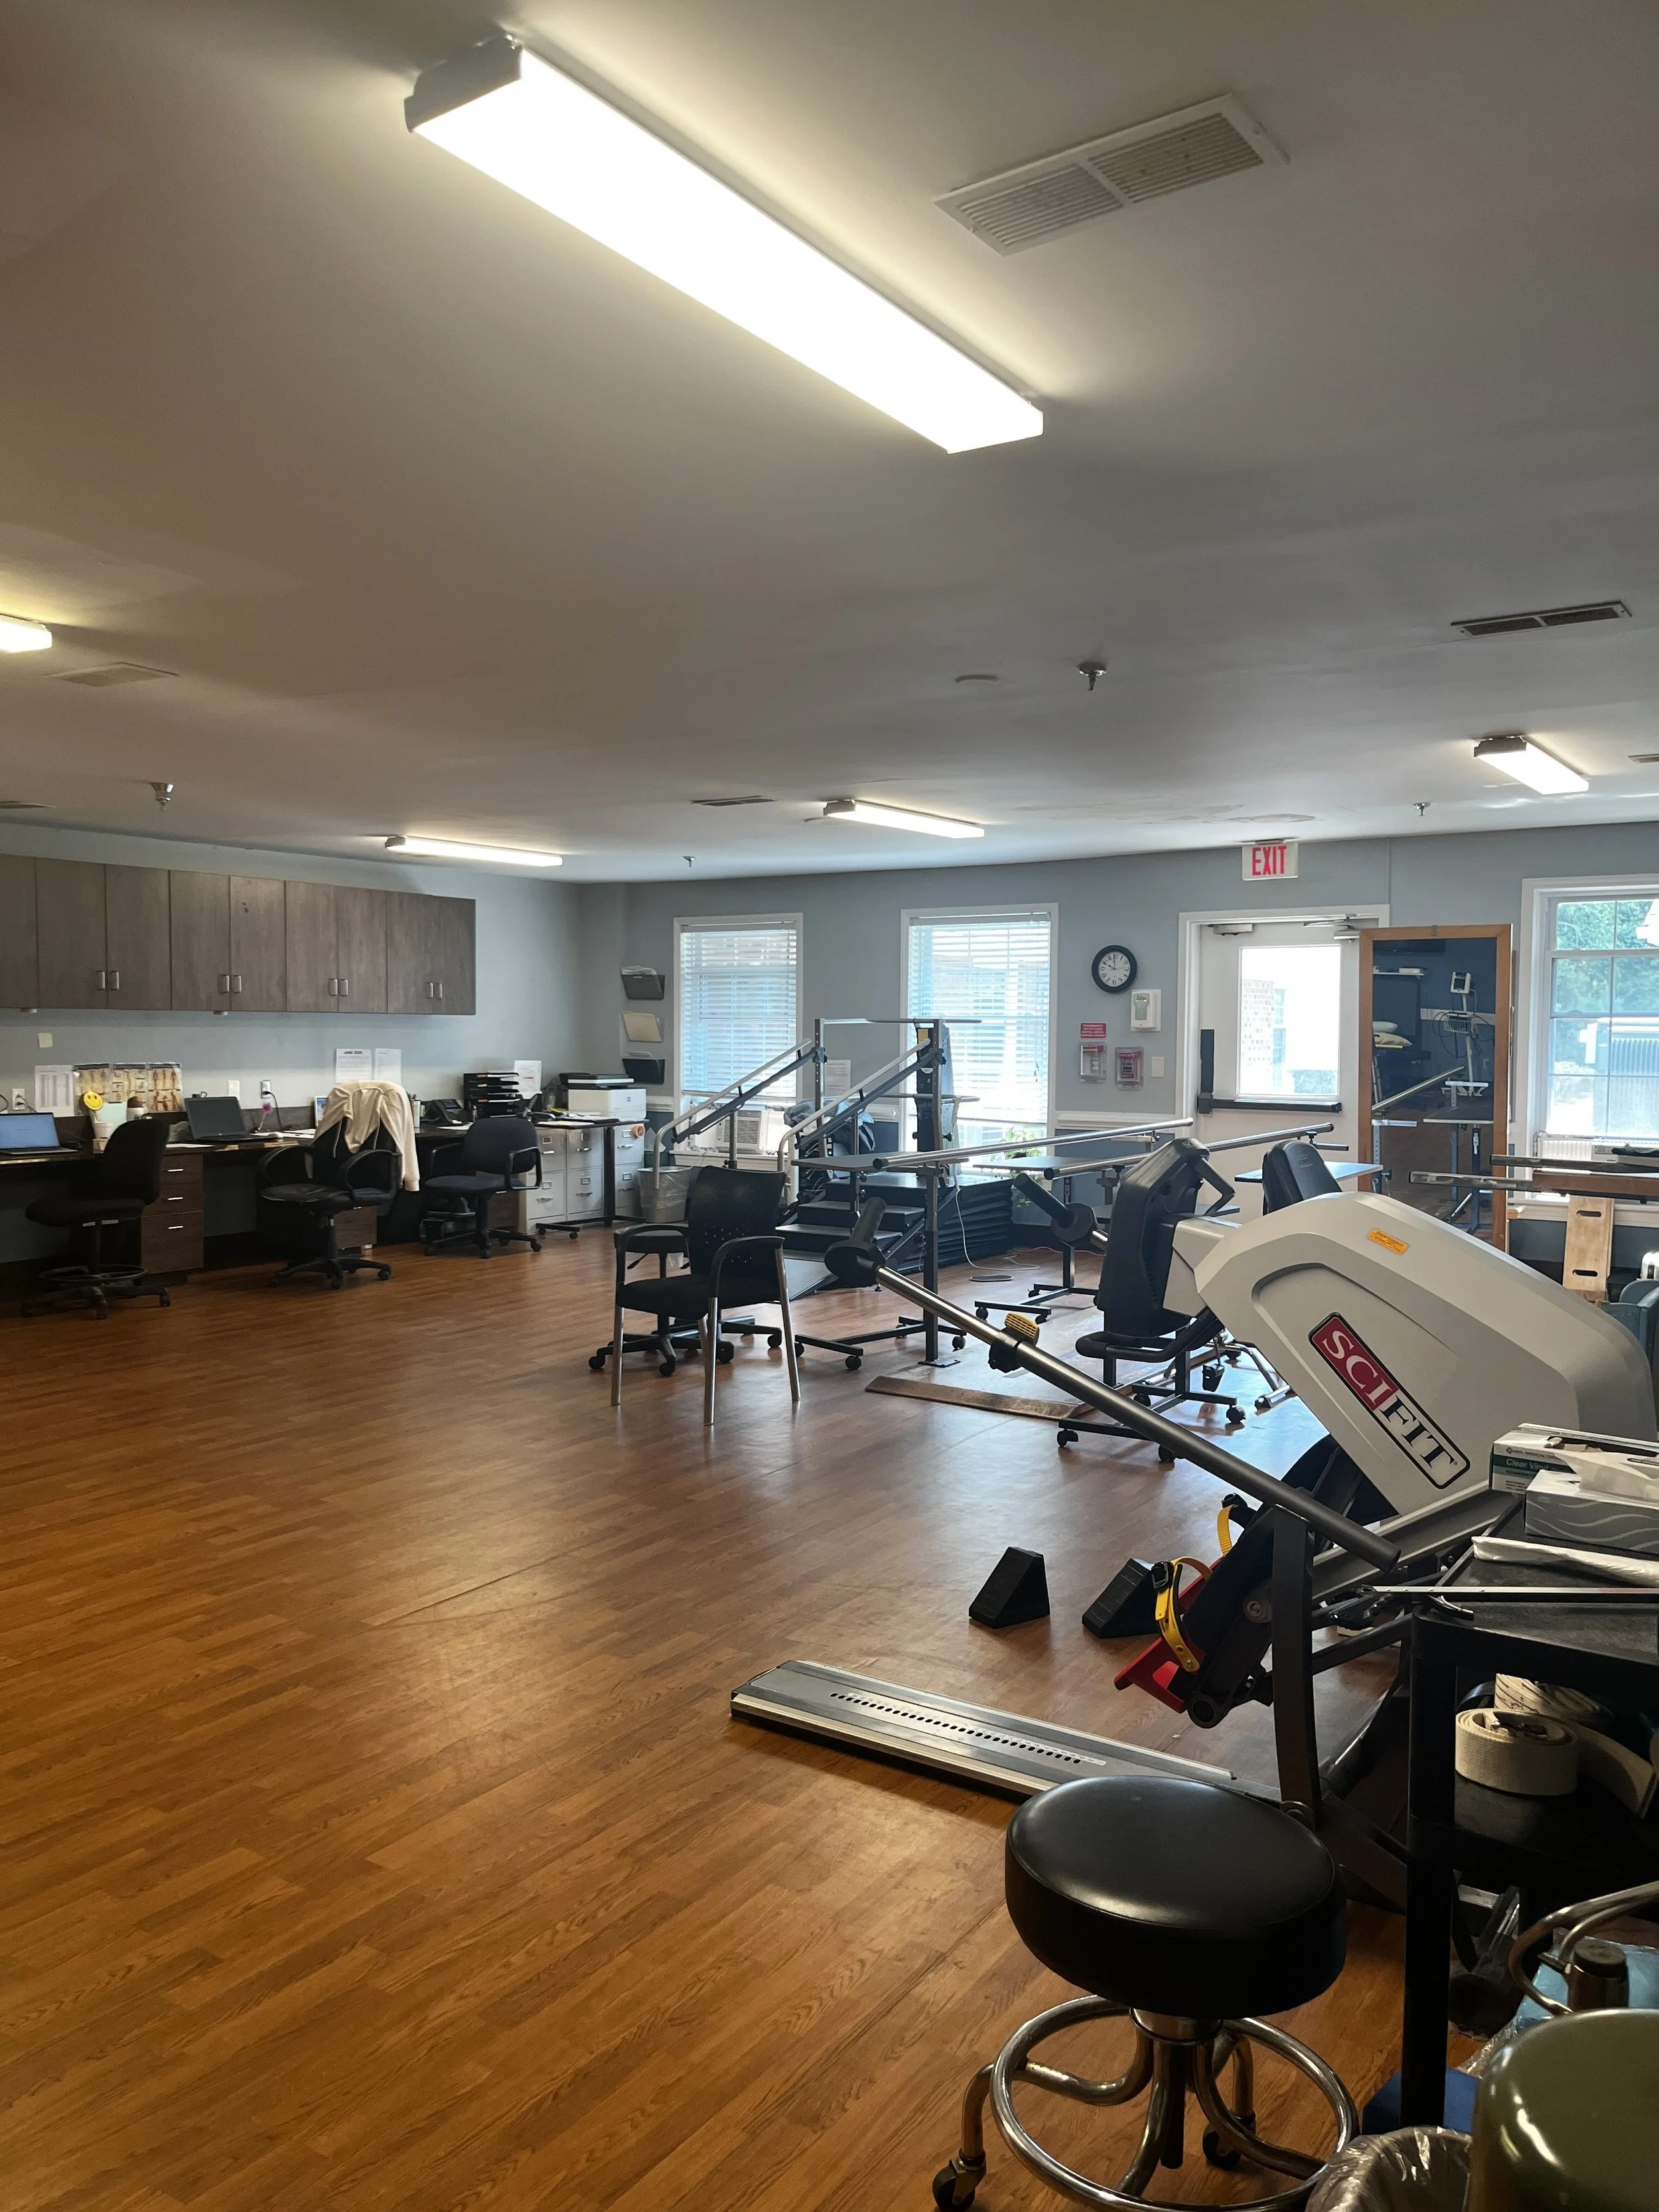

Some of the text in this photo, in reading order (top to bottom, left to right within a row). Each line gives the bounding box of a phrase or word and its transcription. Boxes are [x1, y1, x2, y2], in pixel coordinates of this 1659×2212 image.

[1252, 846, 1287, 875] EXIT
[1322, 1330, 1455, 1468] SCIFIT
[1506, 1458, 1526, 1468] Clear
